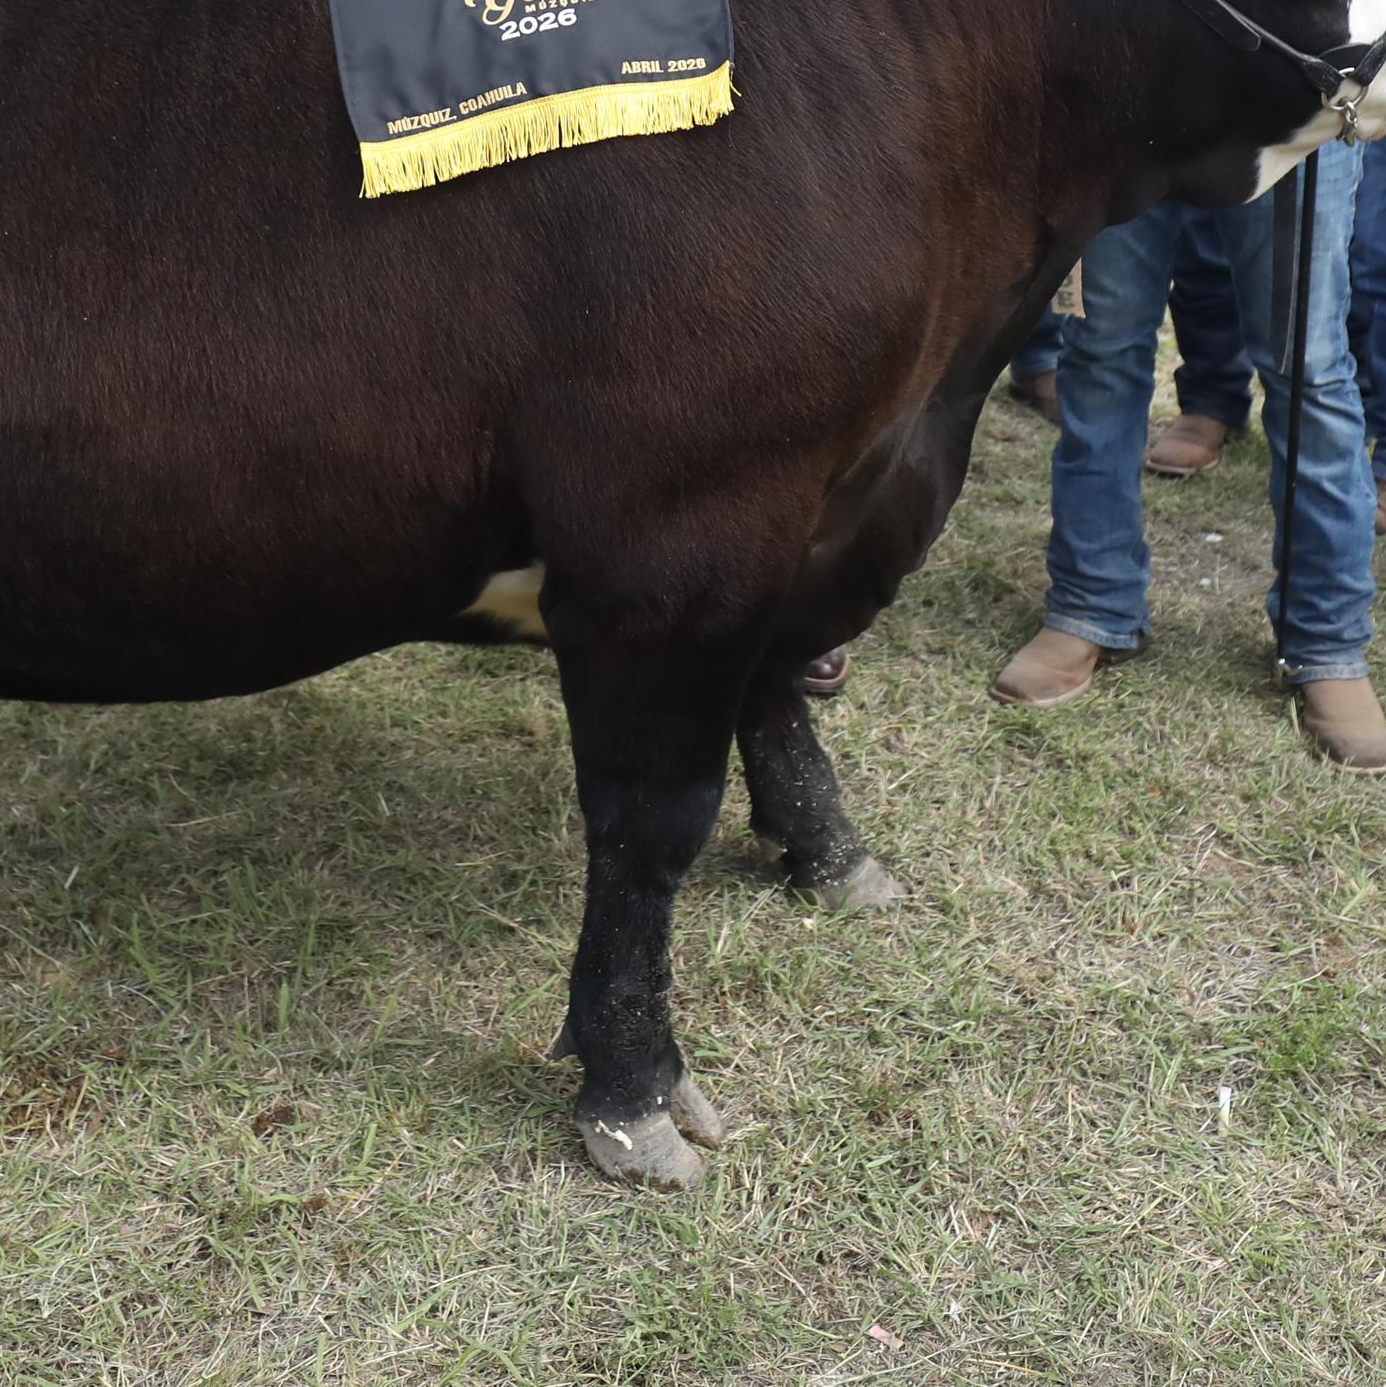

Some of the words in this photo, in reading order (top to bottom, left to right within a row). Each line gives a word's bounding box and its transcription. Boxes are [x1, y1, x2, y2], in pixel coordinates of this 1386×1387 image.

[499, 8, 577, 41] 2026
[621, 60, 664, 74] ABRIL
[386, 107, 457, 135] MÚZQUIZ,
[458, 81, 528, 115] COAHUILA
